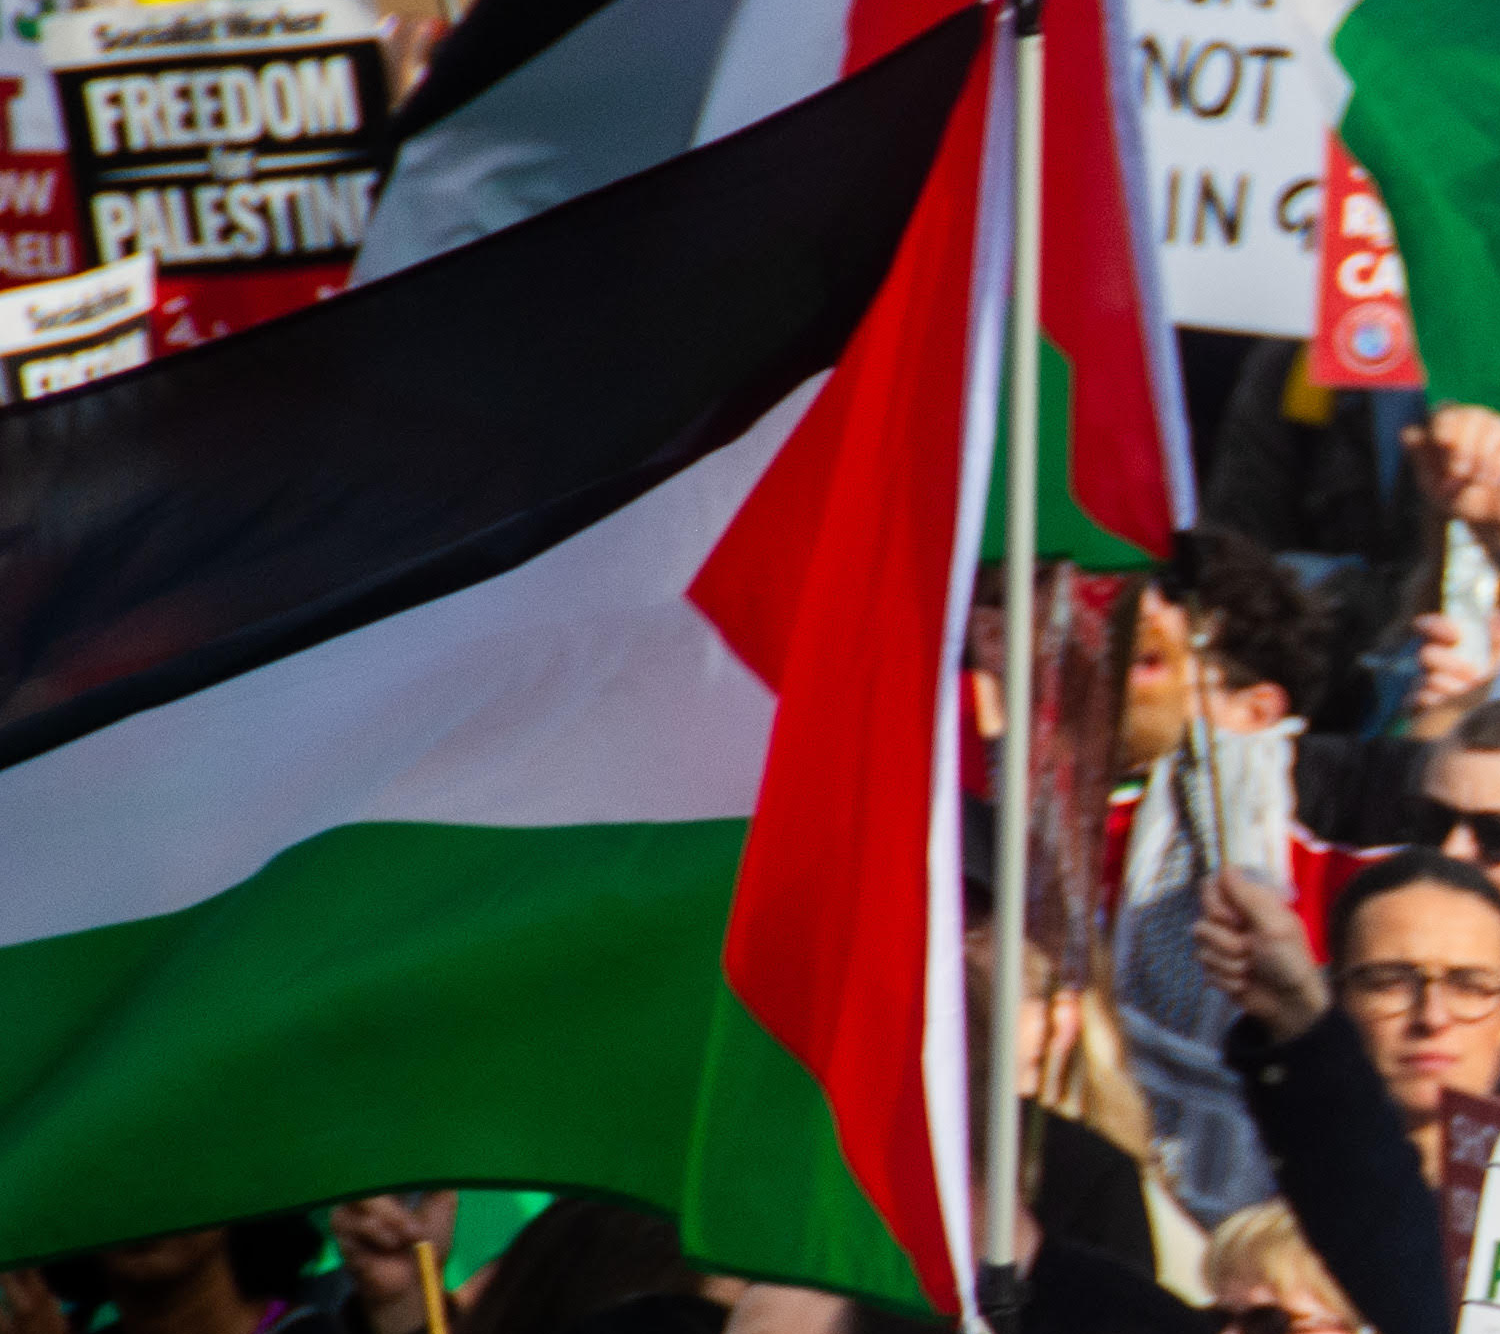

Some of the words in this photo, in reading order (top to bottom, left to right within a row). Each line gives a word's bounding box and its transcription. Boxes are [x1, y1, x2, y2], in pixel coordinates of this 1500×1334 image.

[82, 55, 364, 155] FREEDOM
[1140, 31, 1294, 125] NOT
[1164, 169, 1250, 246] IN
